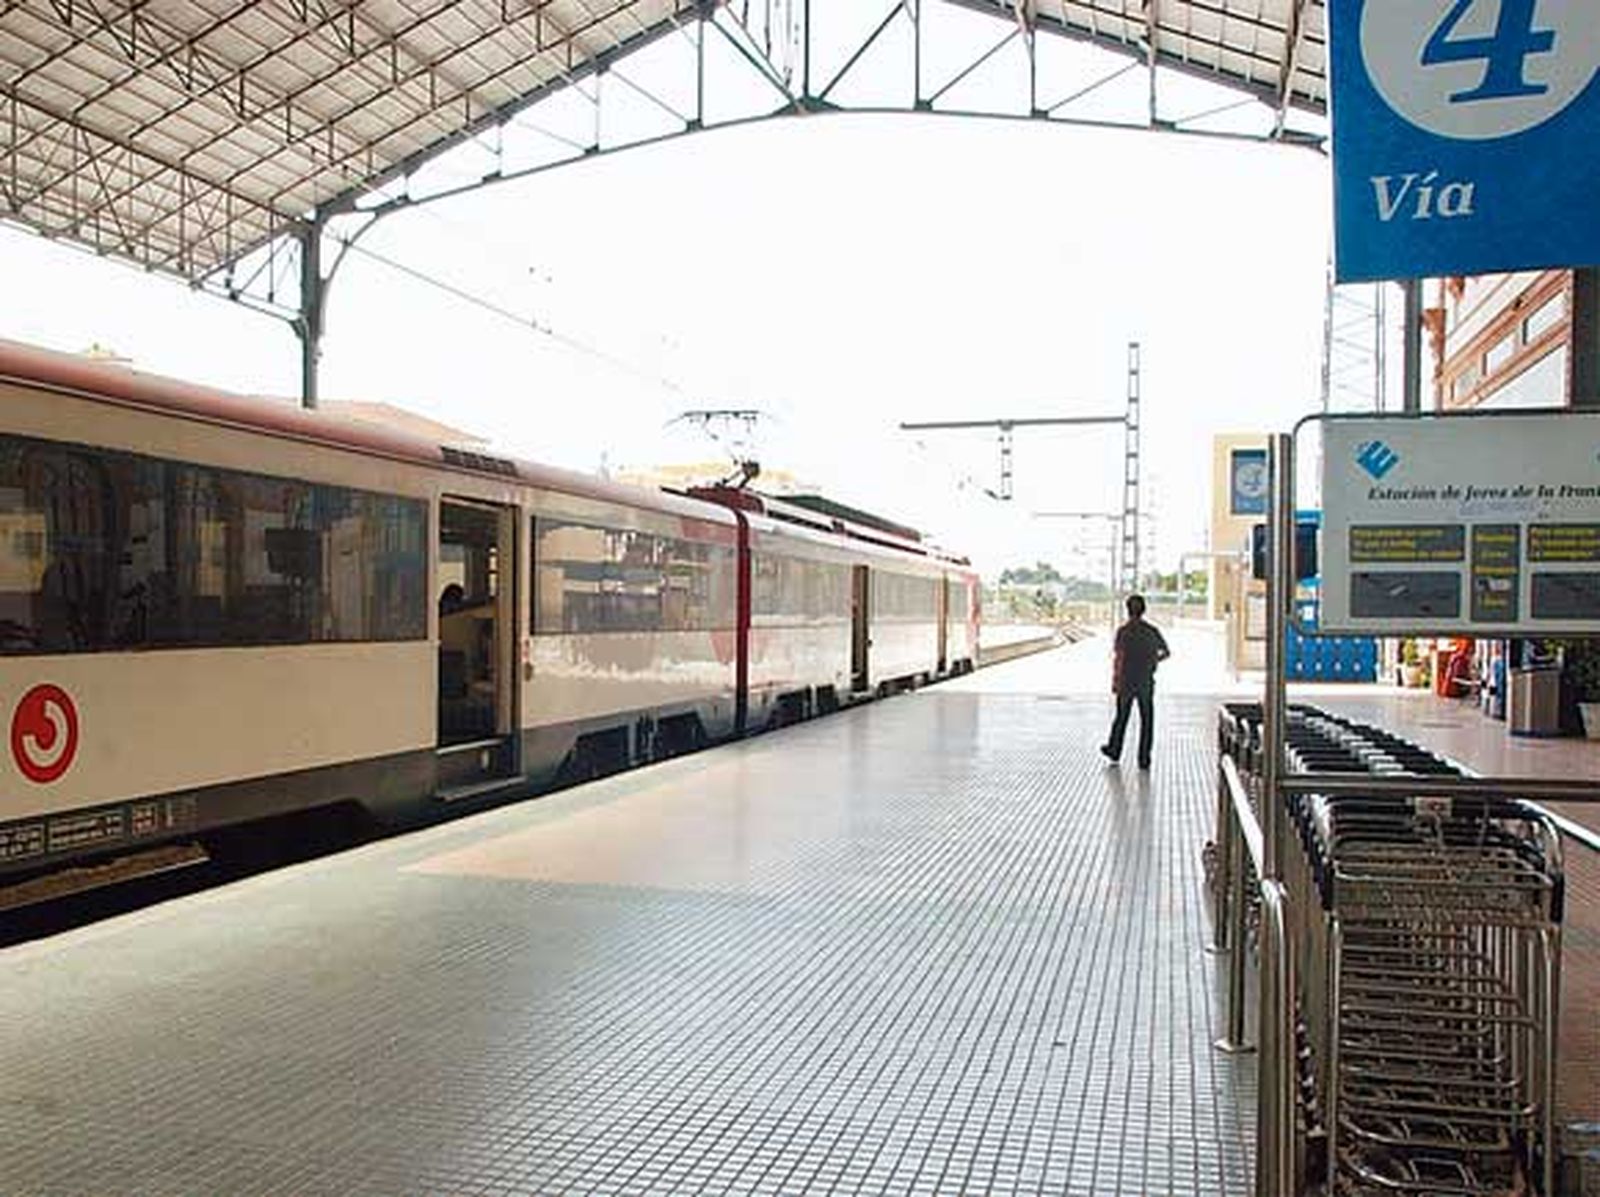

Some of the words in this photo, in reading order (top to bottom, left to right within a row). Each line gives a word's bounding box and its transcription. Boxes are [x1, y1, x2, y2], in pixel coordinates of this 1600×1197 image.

[1420, 0, 1555, 103] 4
[1370, 170, 1475, 222] Vía
[1441, 484, 1461, 500] de
[1512, 484, 1535, 499] de
